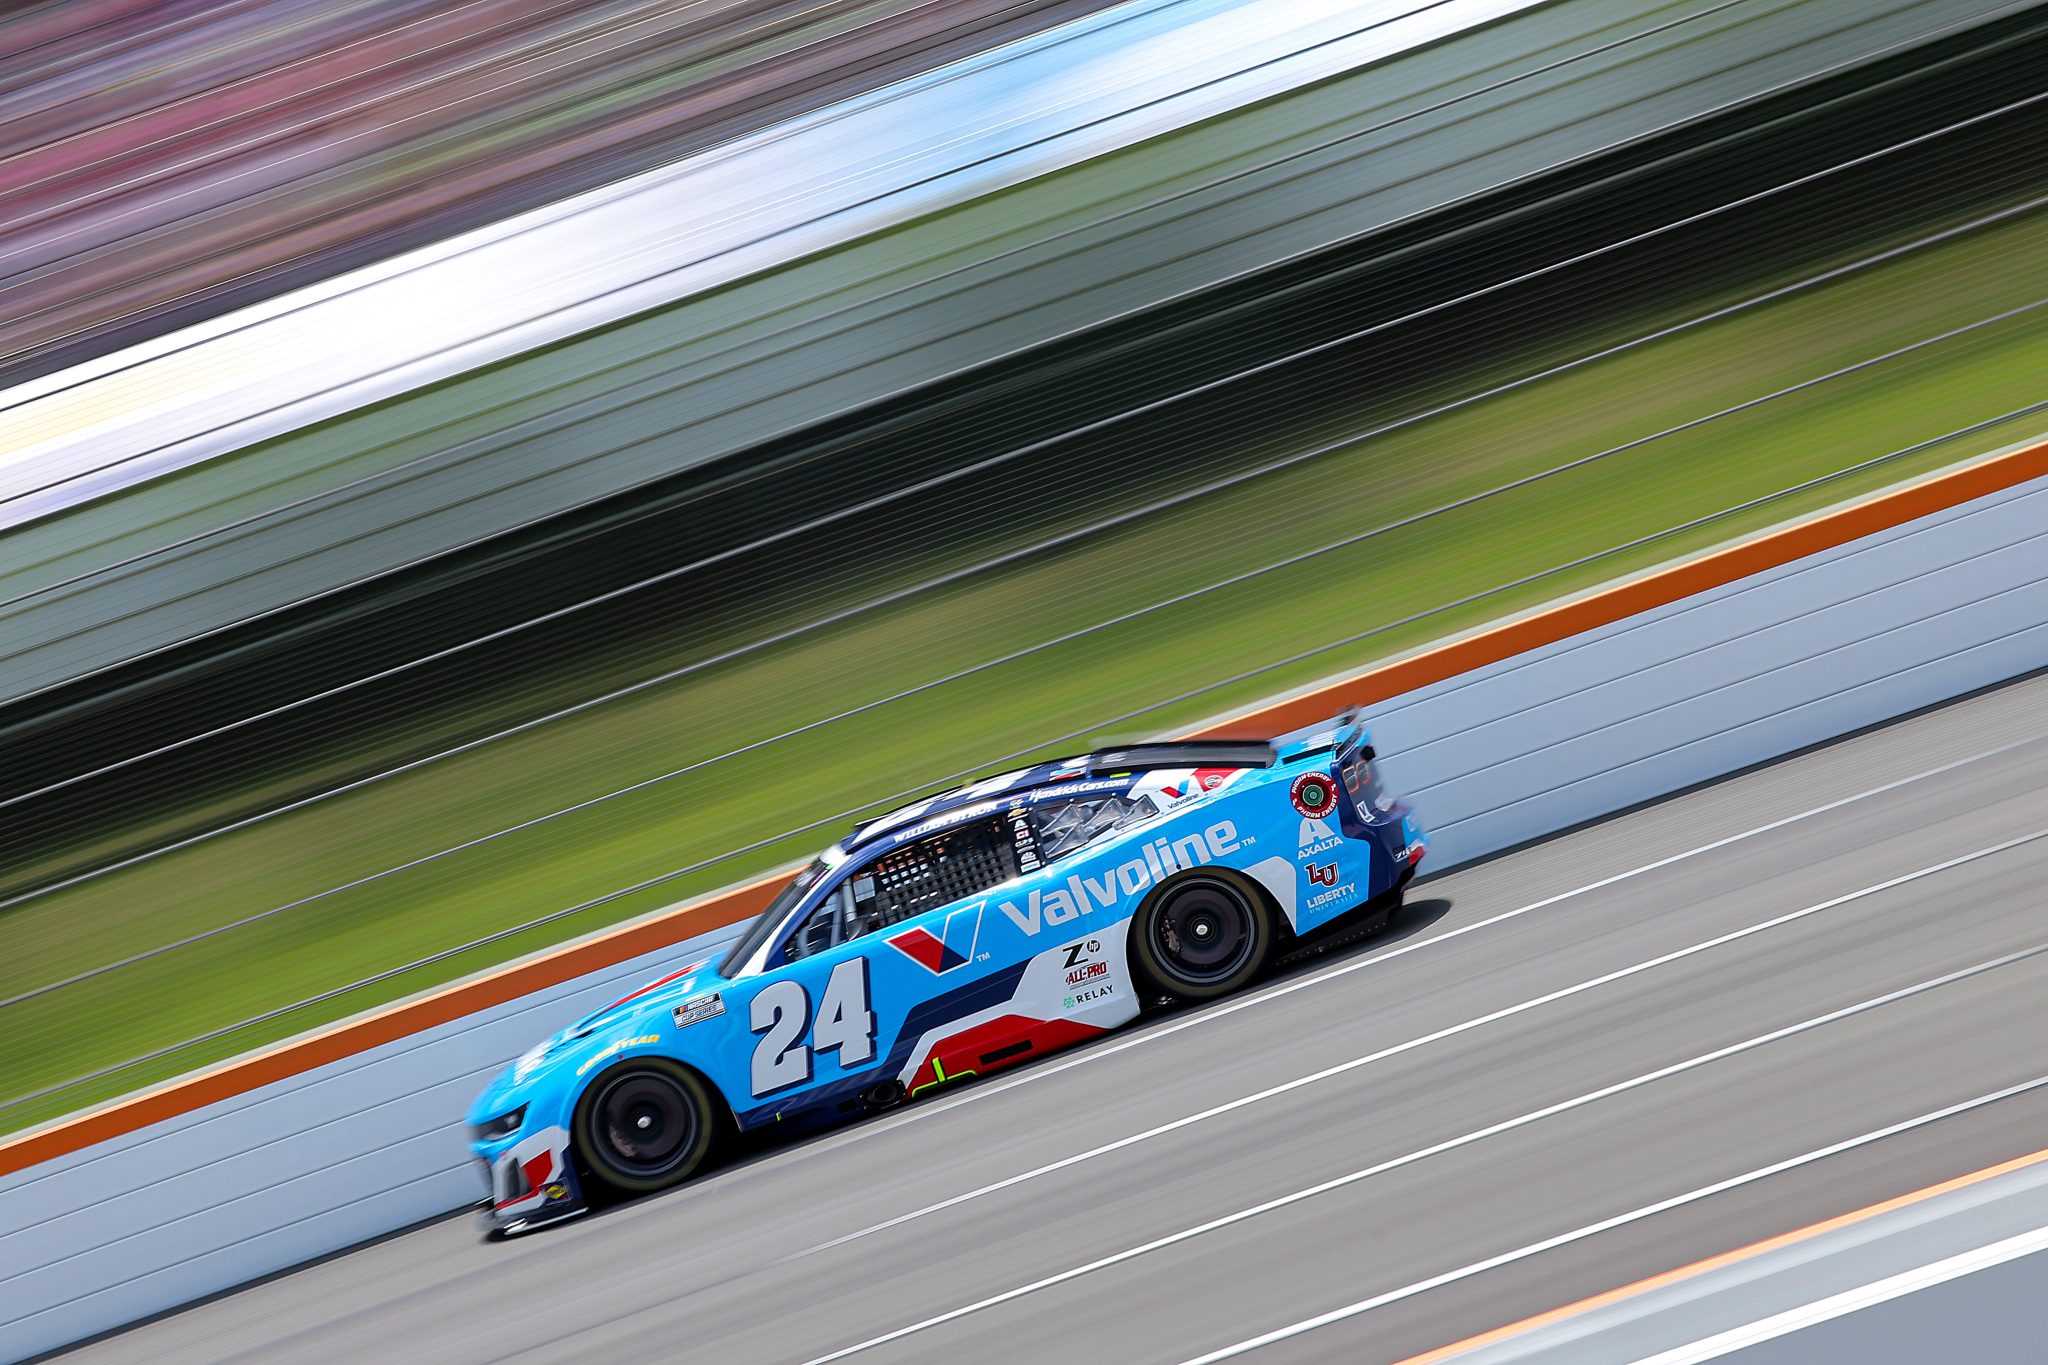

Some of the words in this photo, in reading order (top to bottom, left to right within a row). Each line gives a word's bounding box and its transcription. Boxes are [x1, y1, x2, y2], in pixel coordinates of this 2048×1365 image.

[1167, 793, 1199, 809] Valvoline
[1297, 836, 1344, 860] AXALTA
[998, 820, 1241, 937] Valvoline
[1304, 862, 1340, 888] LU
[1306, 882, 1355, 909] LIBERTY
[976, 951, 991, 962] TM
[1088, 940, 1099, 954] hp
[1067, 961, 1107, 986] ALL-PRO
[687, 996, 714, 1010] NASCAR
[1076, 985, 1114, 1003] RELAY
[681, 1012, 694, 1024] CUP
[694, 1004, 717, 1020] SERIES
[750, 956, 877, 1098] 24
